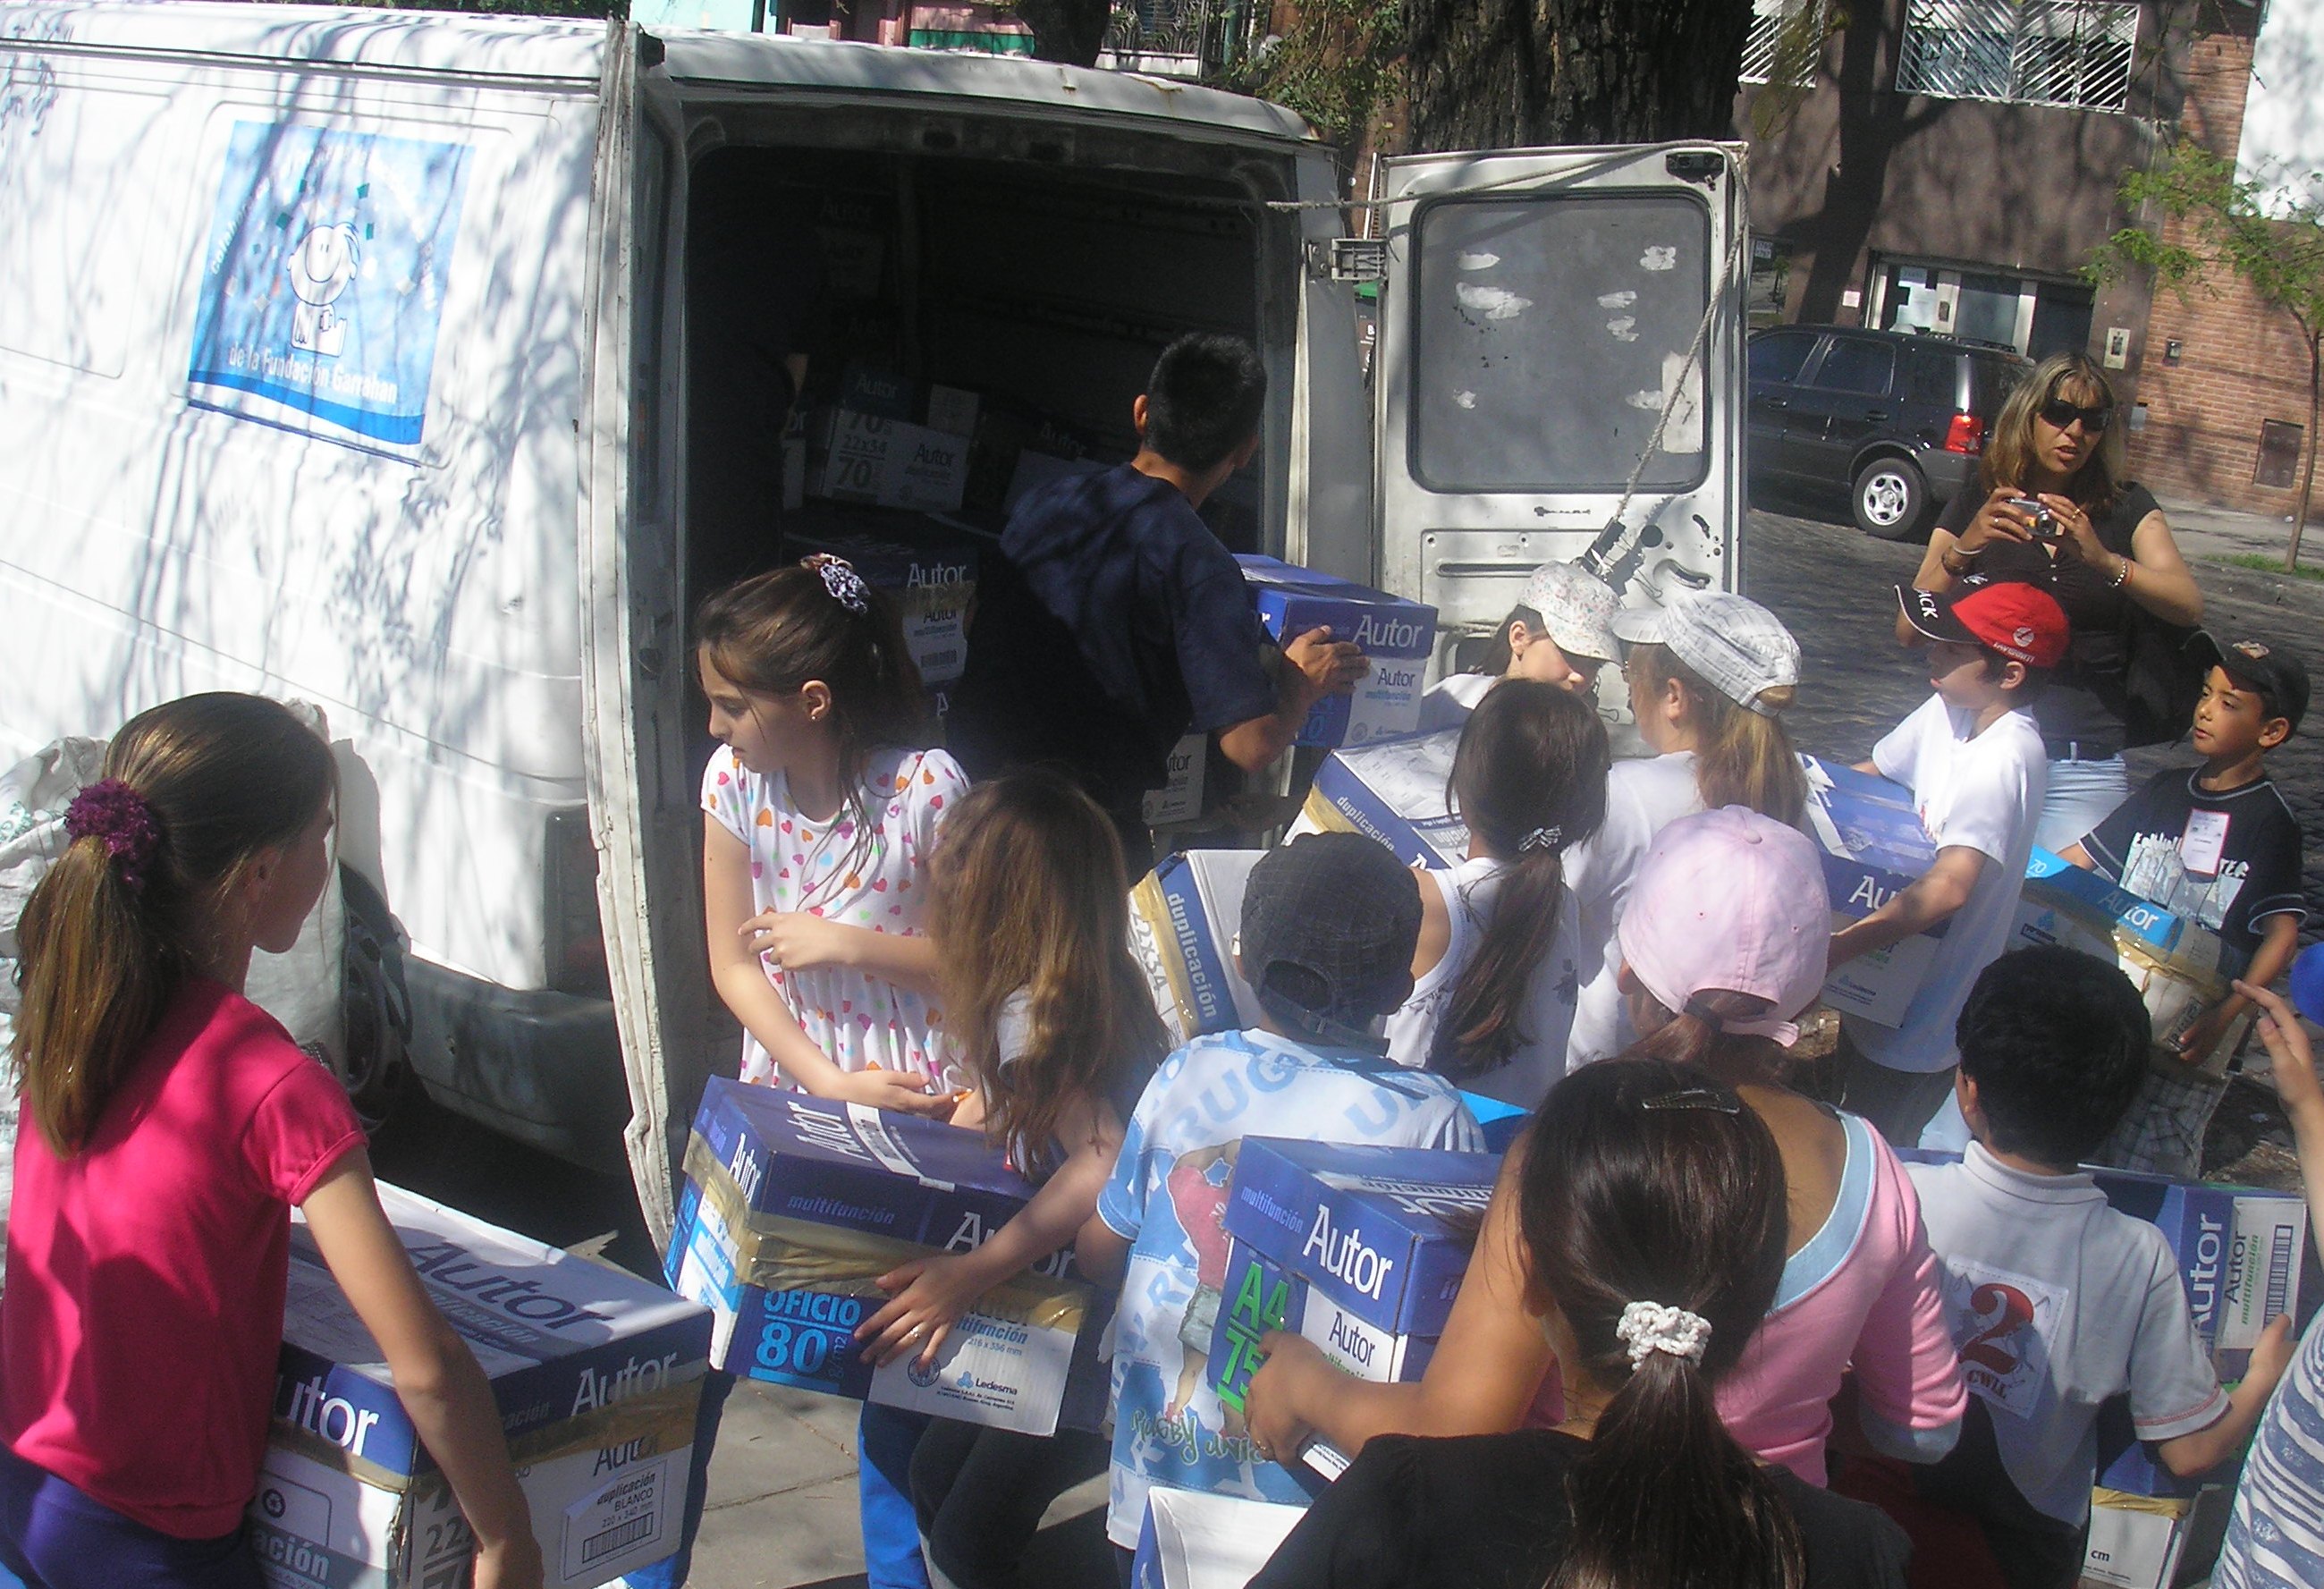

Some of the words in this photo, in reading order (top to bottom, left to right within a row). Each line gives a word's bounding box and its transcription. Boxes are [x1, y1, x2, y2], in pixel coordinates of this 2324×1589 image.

[228, 343, 245, 368] de
[247, 348, 259, 371] la
[262, 351, 329, 389] Fundación
[332, 361, 397, 405] Garrahan
[856, 373, 900, 399] Autor
[836, 455, 872, 489] 70
[914, 443, 955, 467] Autor
[907, 562, 968, 590] Autor
[1352, 613, 1424, 649] Autor
[1377, 667, 1416, 688] Autor
[1336, 796, 1396, 852] duplicación
[1167, 892, 1218, 1018] duplicación
[787, 1100, 874, 1162] Autor
[729, 1132, 761, 1204] Autor
[787, 1195, 895, 1226] multifunción
[1241, 1186, 1304, 1234] multifunción
[1302, 1203, 1394, 1301] Autor
[2224, 1230, 2247, 1305] Autor
[407, 1241, 615, 1331] Autor
[764, 1289, 862, 1326] OFICIO
[1231, 1260, 1289, 1333] A4
[756, 1322, 828, 1374] 80
[1329, 1310, 1376, 1367] Autor
[1956, 1282, 2035, 1375] 2
[570, 1351, 678, 1418] Autor
[976, 1377, 1018, 1396] Ledesma
[272, 1374, 380, 1457] utor
[614, 1487, 654, 1512] BLANCO
[2091, 1549, 2110, 1562] cm
